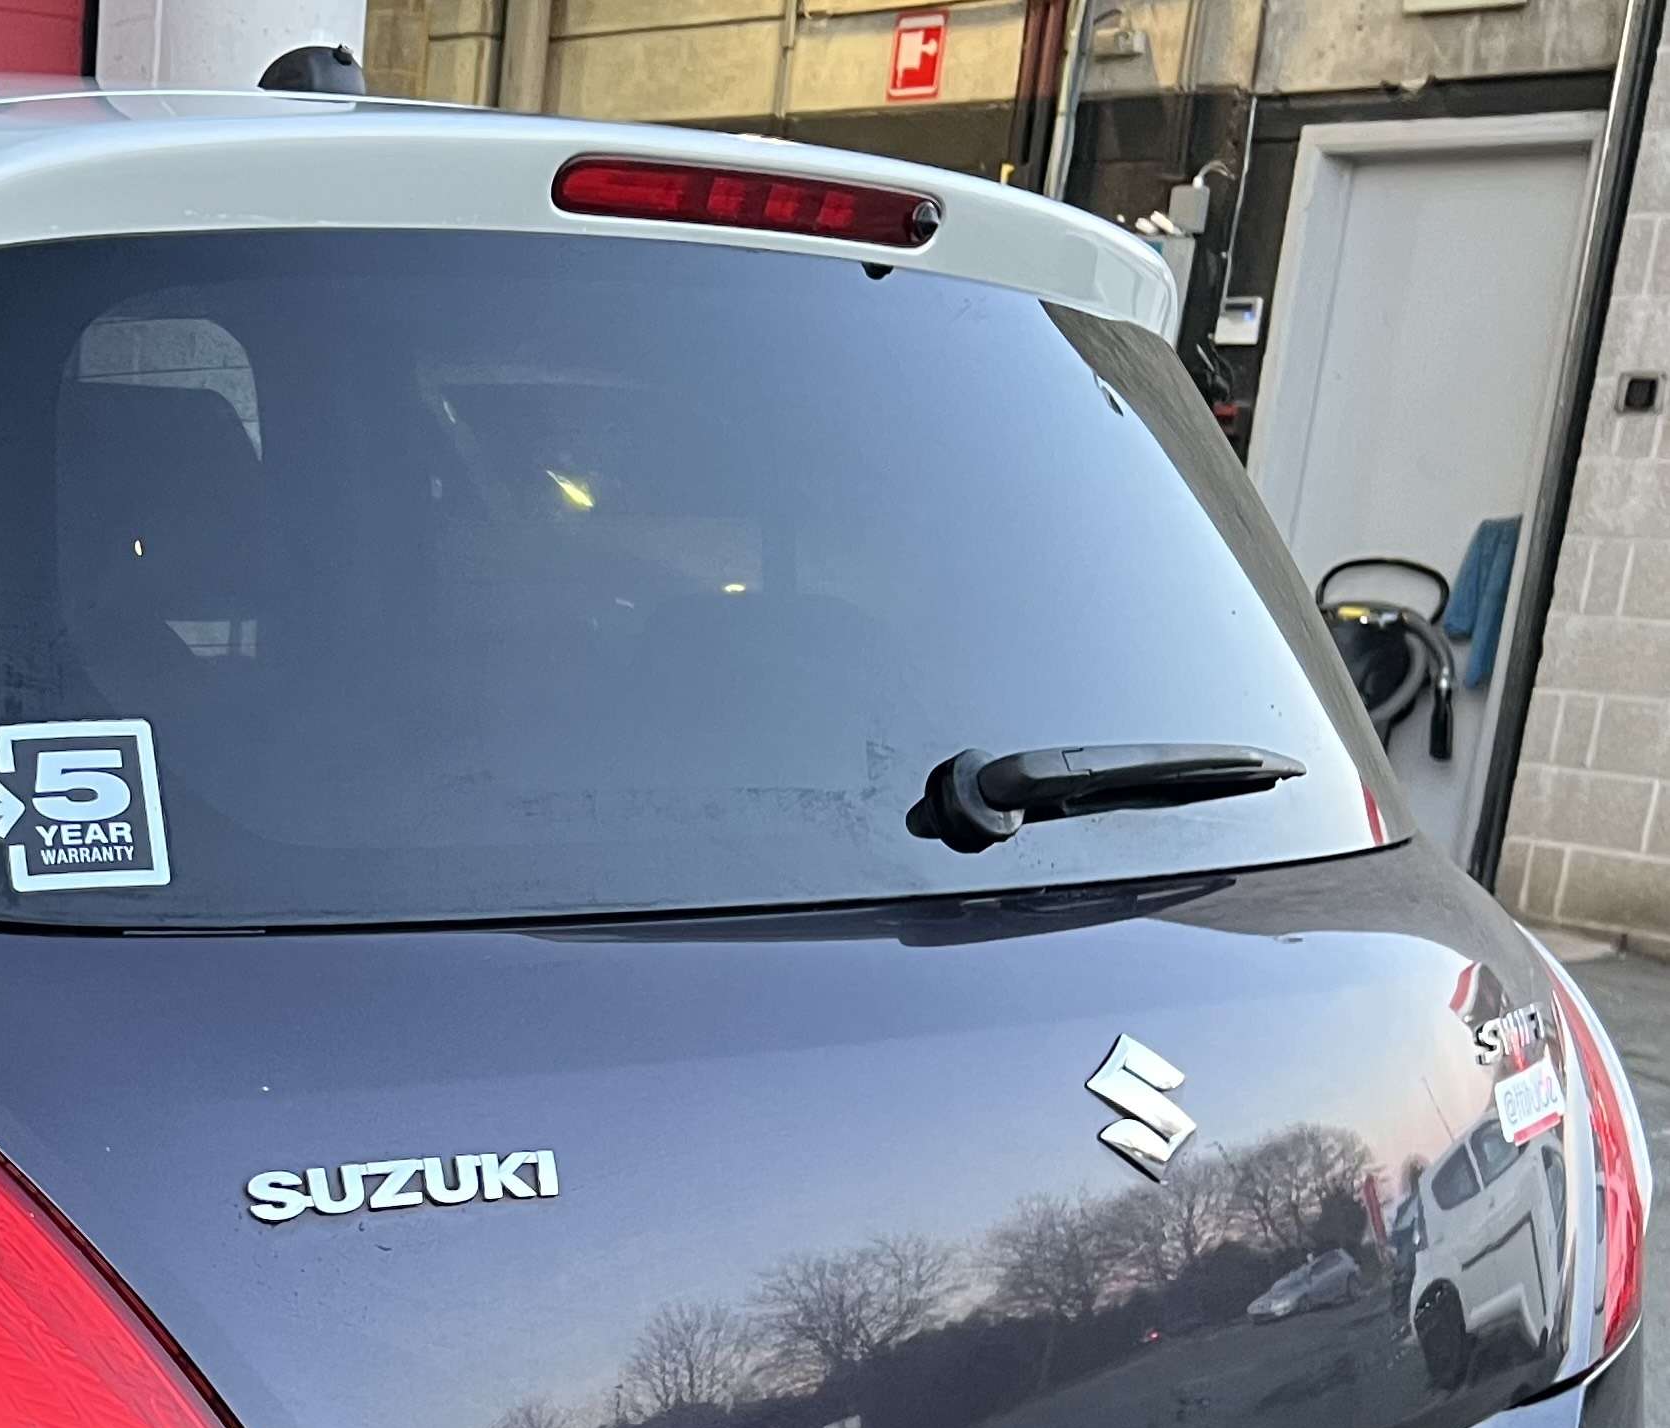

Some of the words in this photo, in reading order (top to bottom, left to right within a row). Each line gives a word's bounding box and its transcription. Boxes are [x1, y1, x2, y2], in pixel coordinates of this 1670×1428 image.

[32, 749, 131, 822] 5
[35, 821, 134, 847] YEAR
[40, 845, 135, 866] WARRANTY
[246, 1150, 560, 1222] SUZUKI
